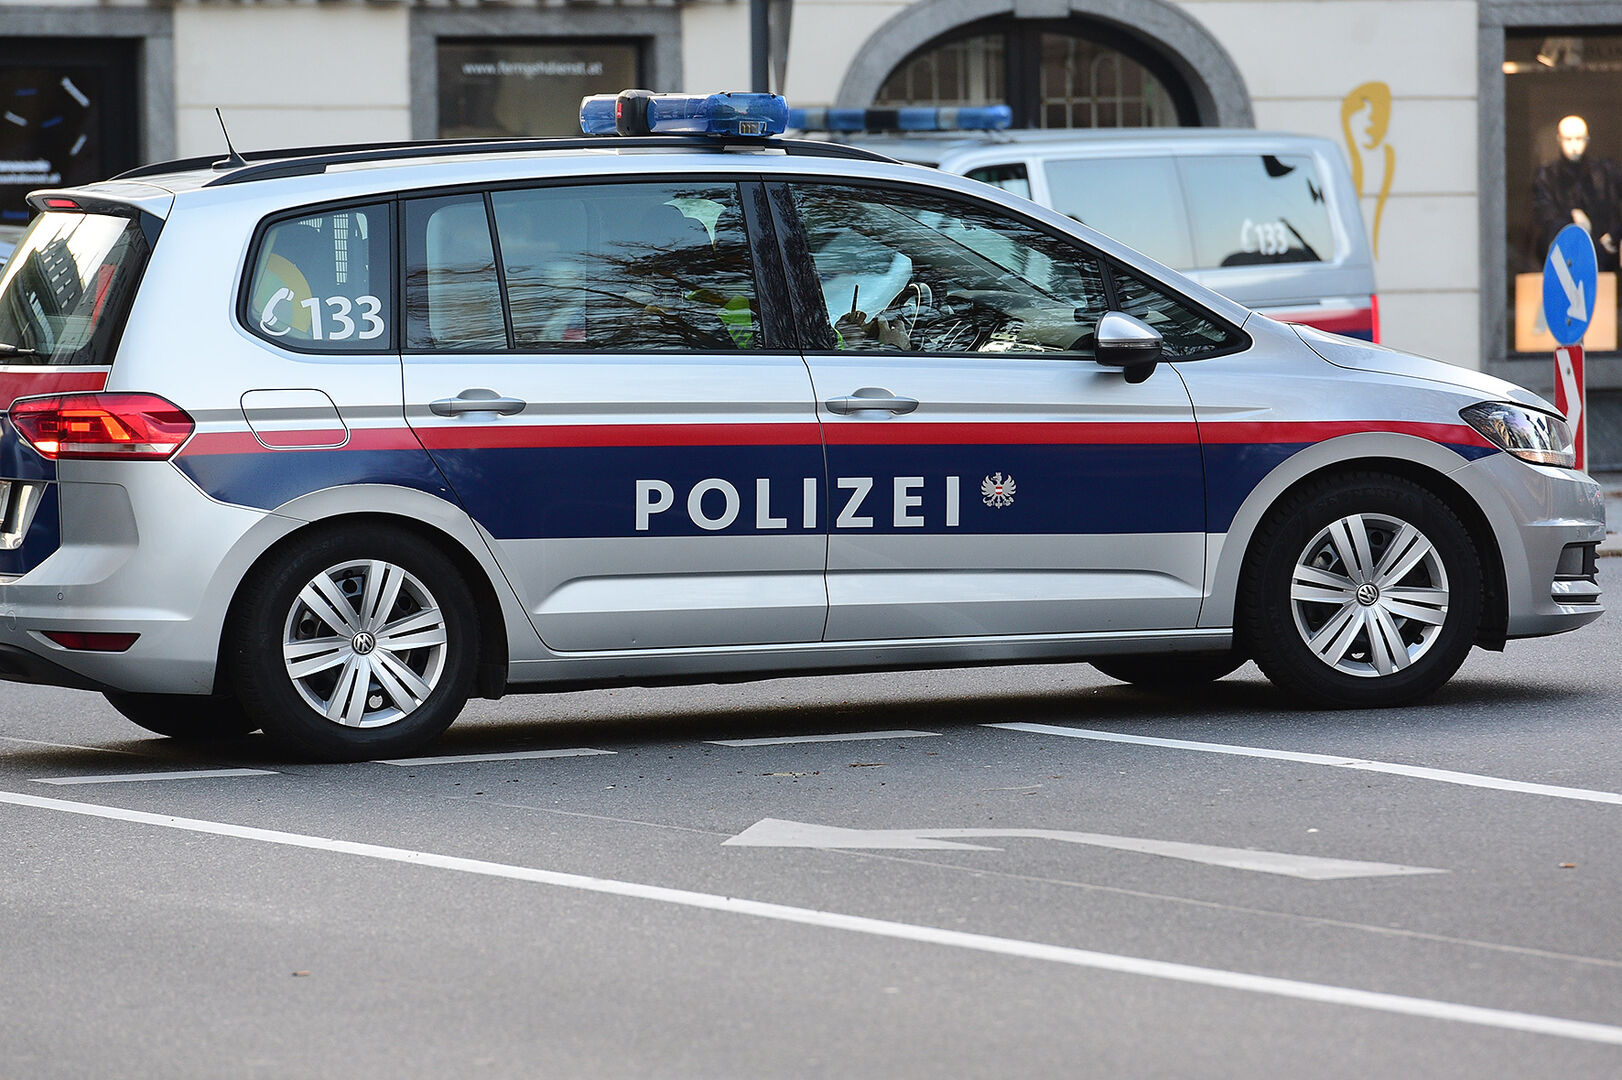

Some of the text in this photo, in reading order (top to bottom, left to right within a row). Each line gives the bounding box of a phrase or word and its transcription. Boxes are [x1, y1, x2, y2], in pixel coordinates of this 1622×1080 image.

[1254, 223, 1288, 255] 133
[300, 295, 385, 340] 133
[635, 475, 960, 531] POLIZEI
